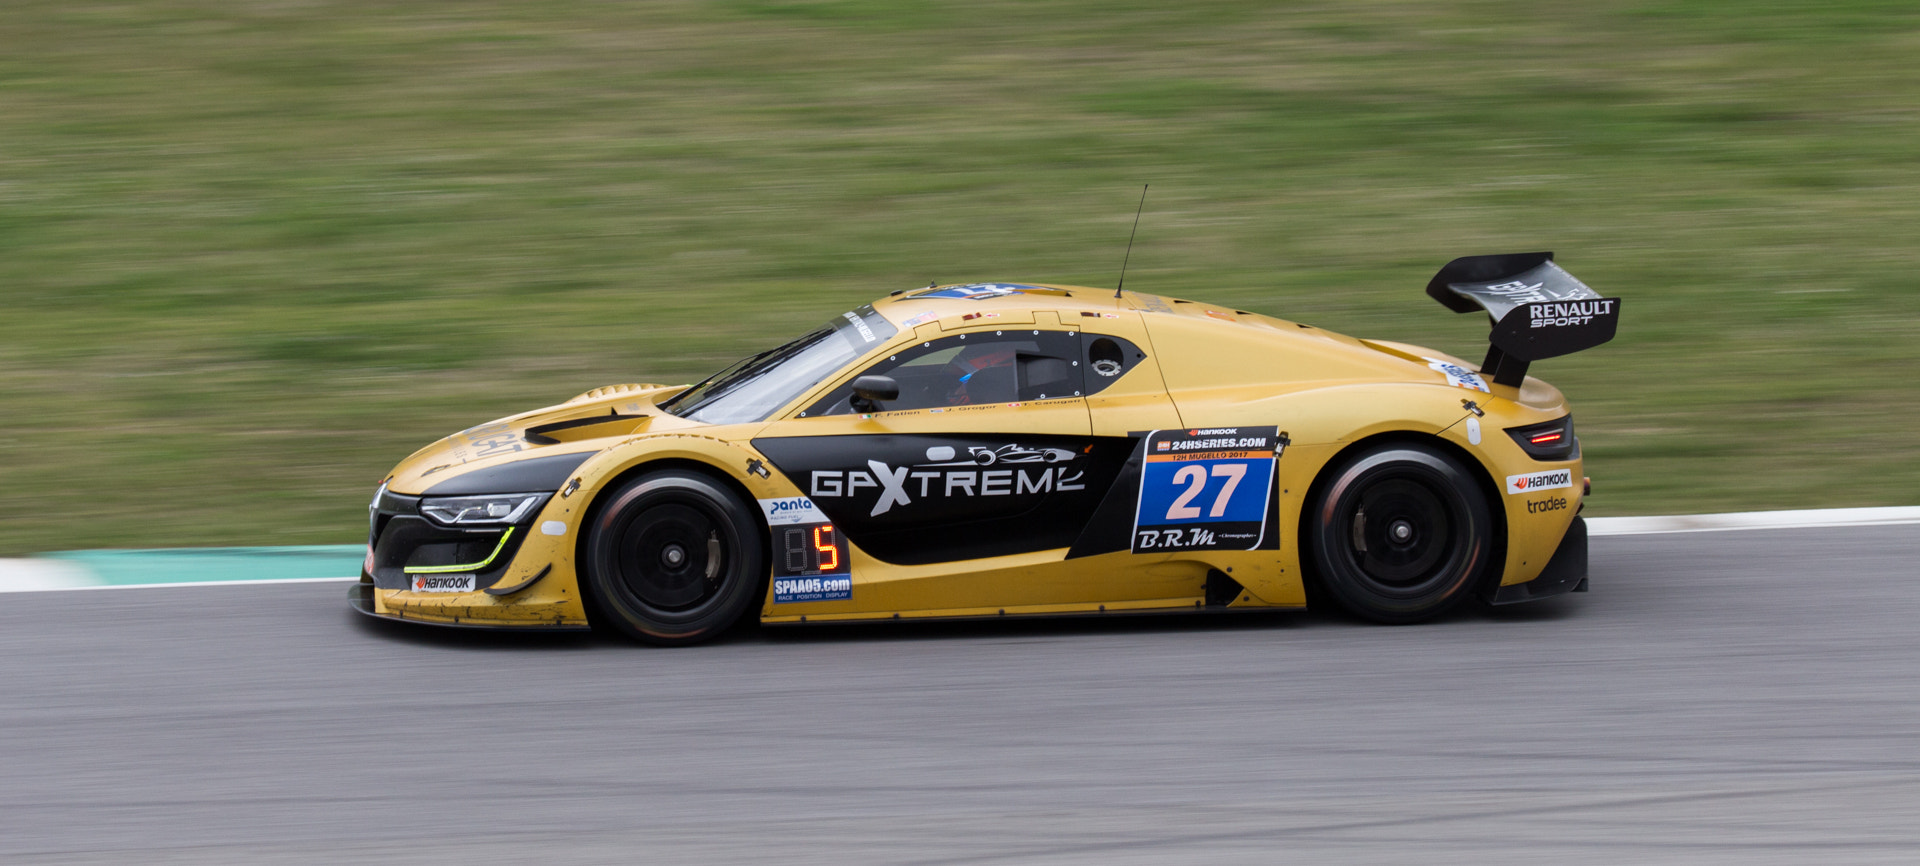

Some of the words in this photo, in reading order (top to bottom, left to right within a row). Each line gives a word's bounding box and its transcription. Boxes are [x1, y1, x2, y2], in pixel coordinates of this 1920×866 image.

[1529, 300, 1614, 319] RENAULT
[1530, 315, 1594, 329] SPORT
[1171, 437, 1267, 451] 24HSERIES.COM
[1165, 463, 1248, 520] 27
[770, 497, 812, 515] panta
[1527, 496, 1567, 514] tradee
[814, 525, 838, 570] 5
[775, 579, 850, 595] SPAA05.com
